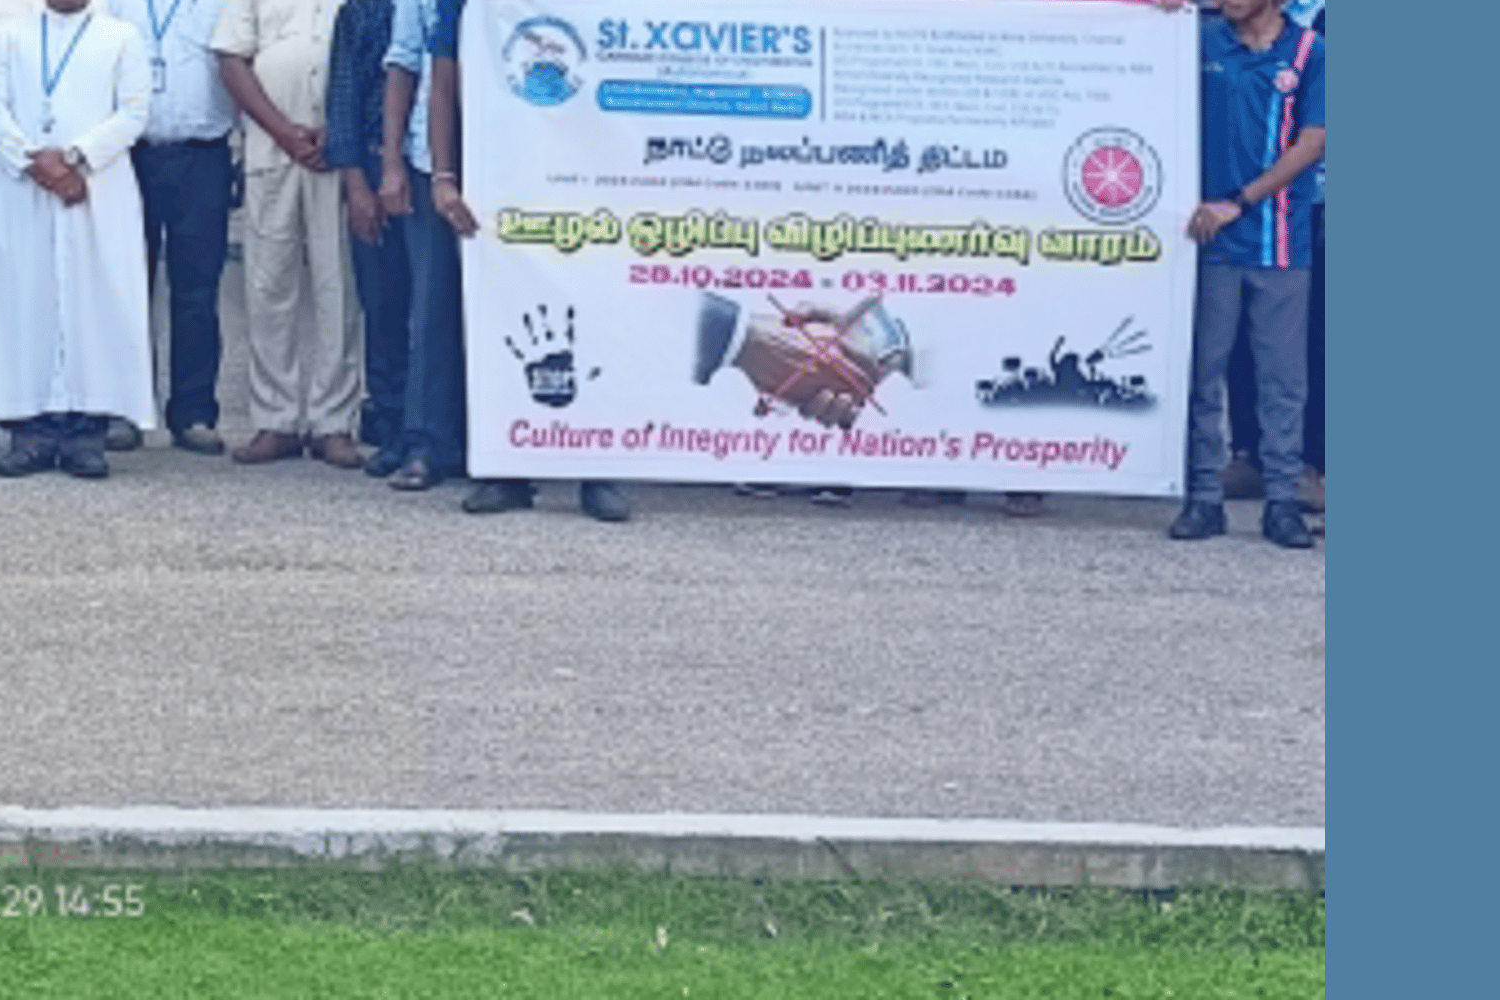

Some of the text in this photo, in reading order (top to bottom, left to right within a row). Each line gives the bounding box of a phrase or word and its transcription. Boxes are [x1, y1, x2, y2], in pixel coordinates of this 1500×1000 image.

[597, 18, 640, 50] St.
[498, 208, 1162, 266] ஊழல் ஒழிப்பு விழிப்புணர்வு வாரம்
[508, 418, 1131, 472] Culture of Integrity for Nation's Prosperity
